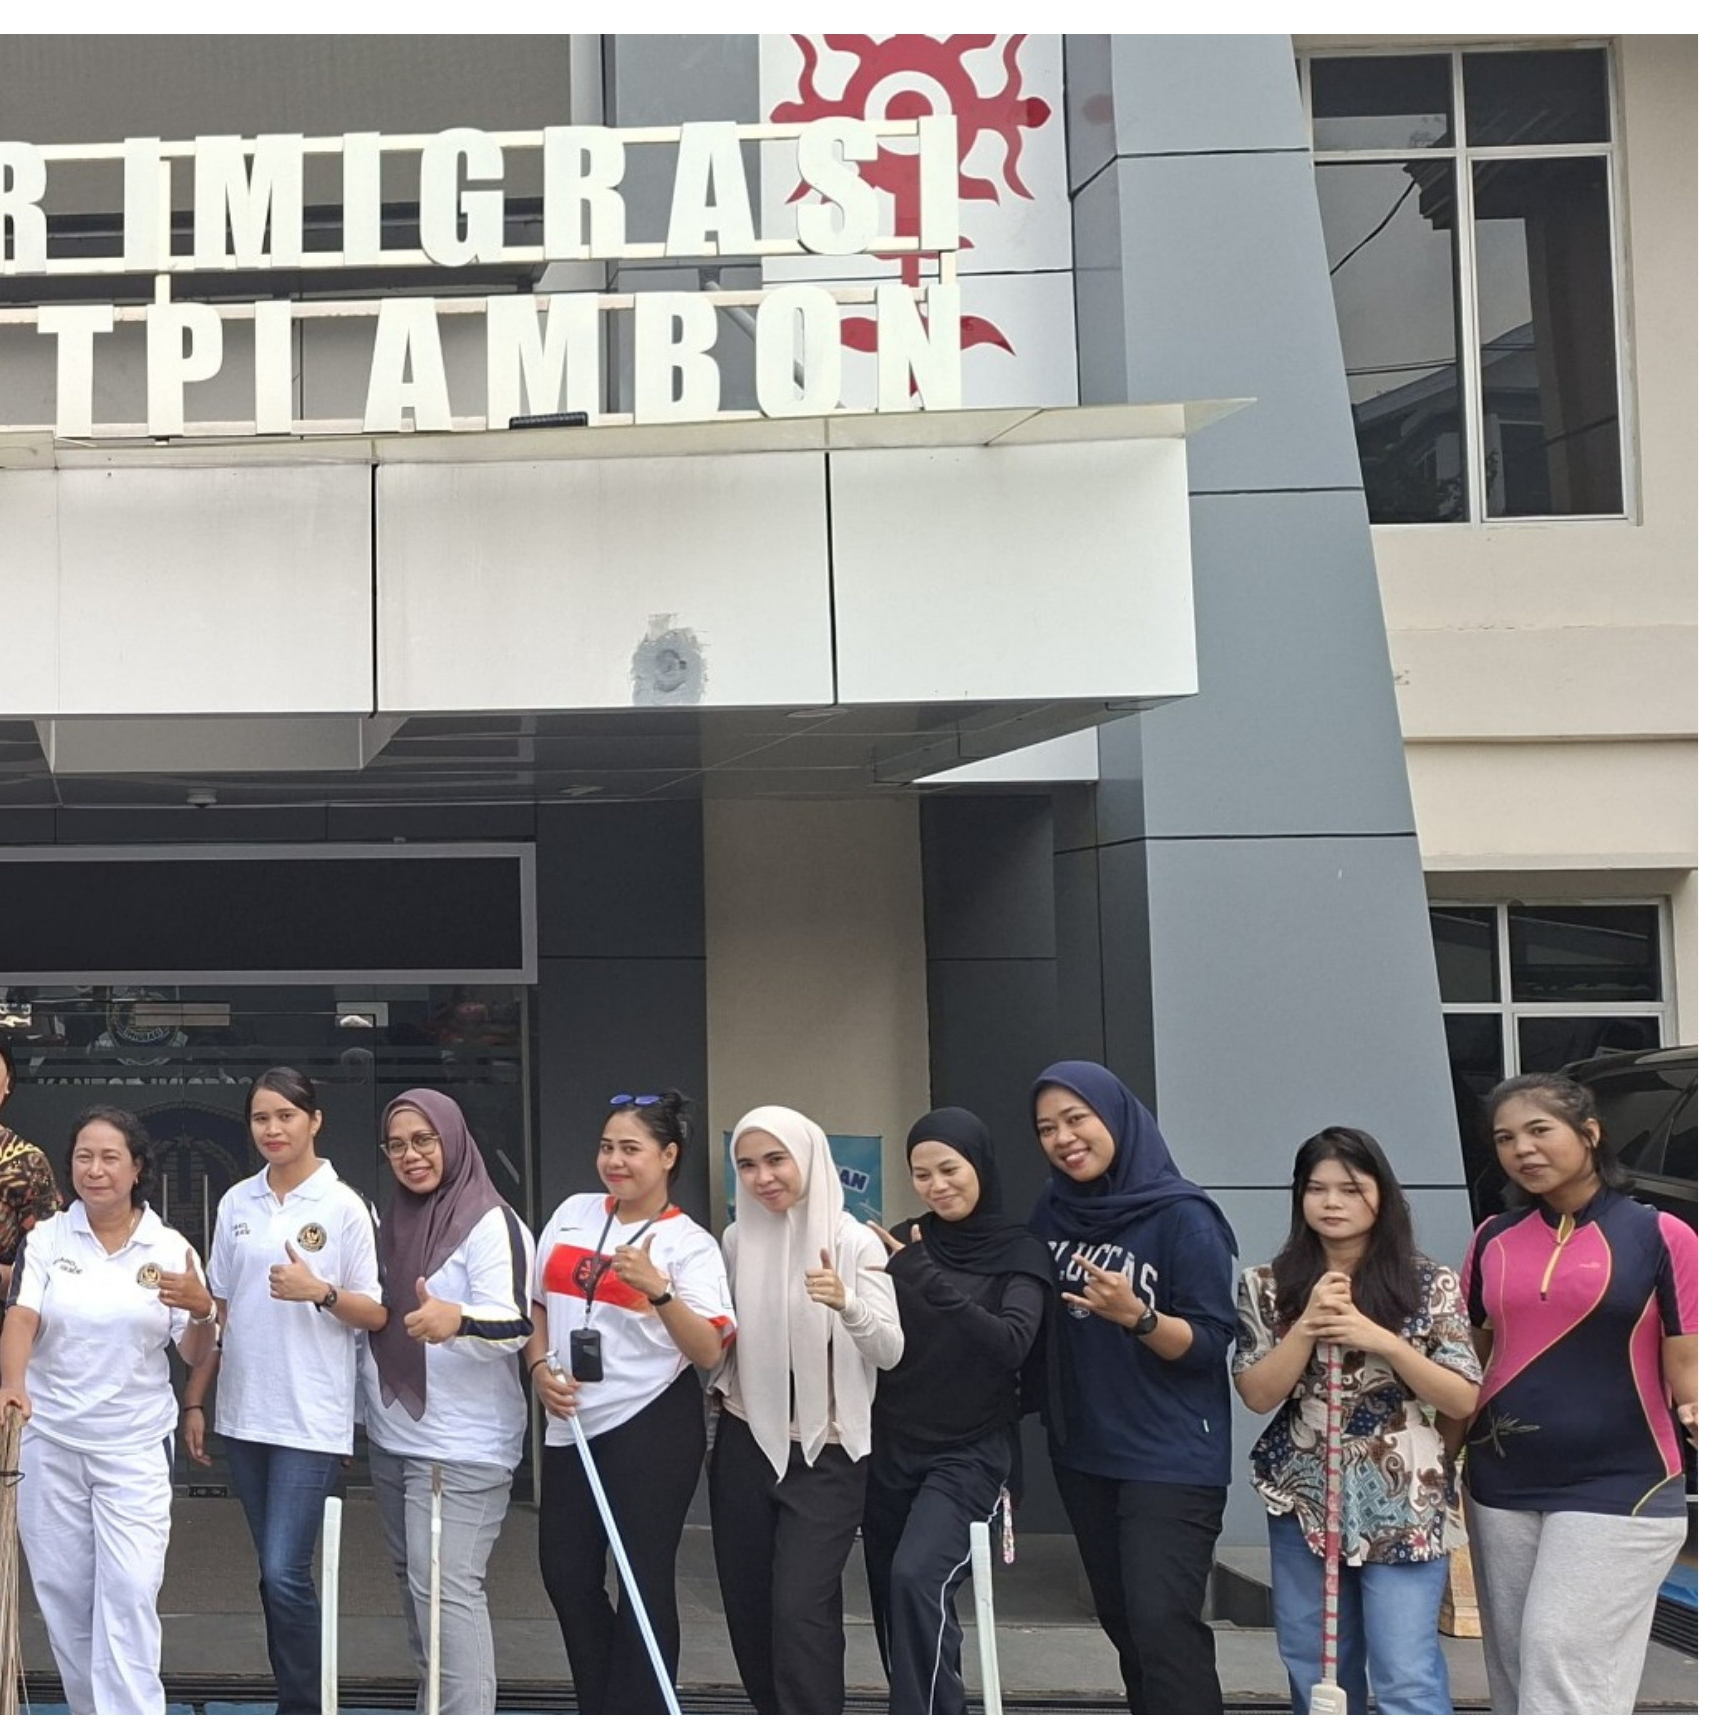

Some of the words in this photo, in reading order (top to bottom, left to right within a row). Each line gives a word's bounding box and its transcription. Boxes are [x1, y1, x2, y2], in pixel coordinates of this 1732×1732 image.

[123, 114, 960, 272] IMIGRASI
[37, 299, 293, 438] TPI
[364, 283, 962, 433] AMBON
